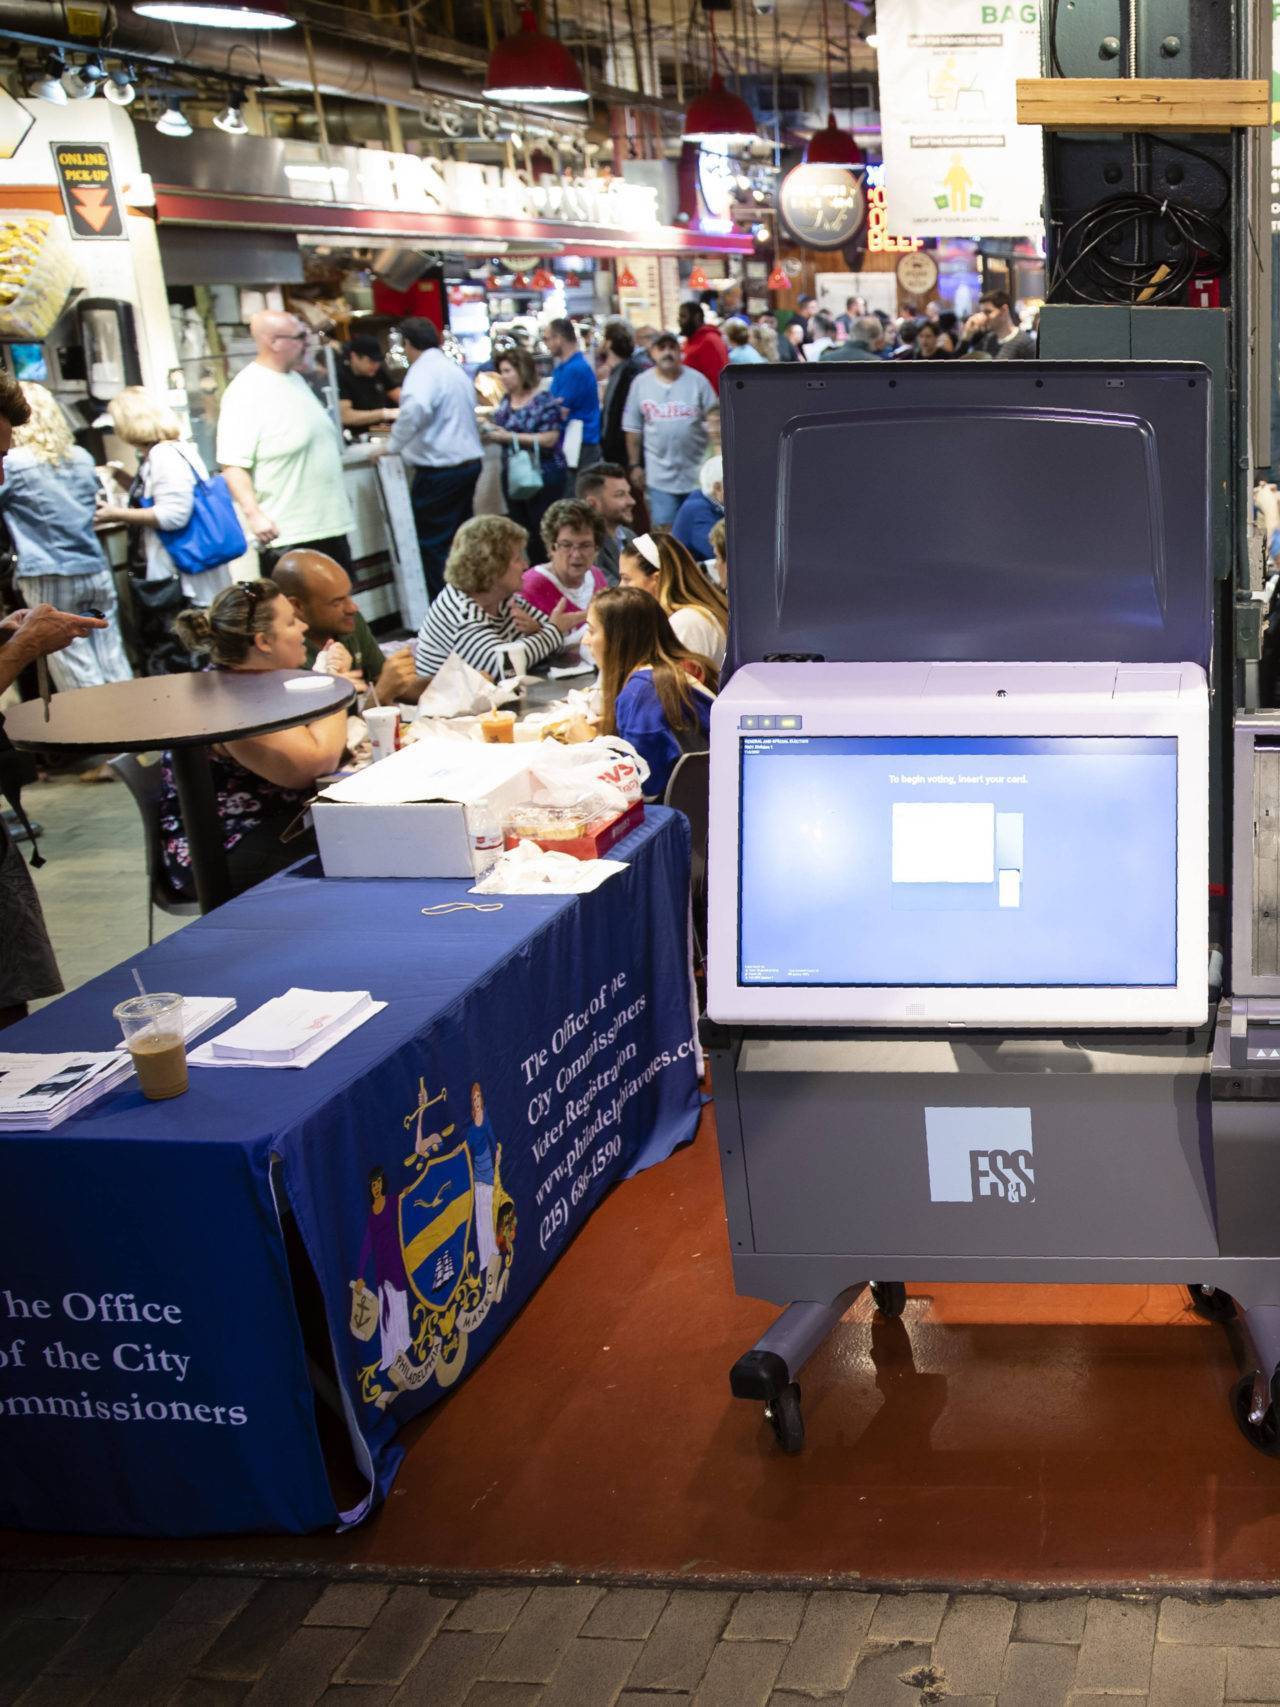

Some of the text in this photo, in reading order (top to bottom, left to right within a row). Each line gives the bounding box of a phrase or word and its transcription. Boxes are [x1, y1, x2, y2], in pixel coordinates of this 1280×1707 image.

[58, 152, 108, 166] ONLINE
[889, 774, 1029, 786] To begin voting, insert your card.
[589, 985, 607, 1016] of
[556, 994, 647, 1095] Comissners
[531, 1041, 637, 1166] Voter Registraion
[539, 1134, 622, 1252] (215) 686-1590
[0, 1290, 183, 1325] he Office
[42, 1341, 101, 1371] the
[112, 1342, 191, 1382] City
[394, 1341, 441, 1386] PHILADELPHIA
[0, 1390, 248, 1426] mmissioners
